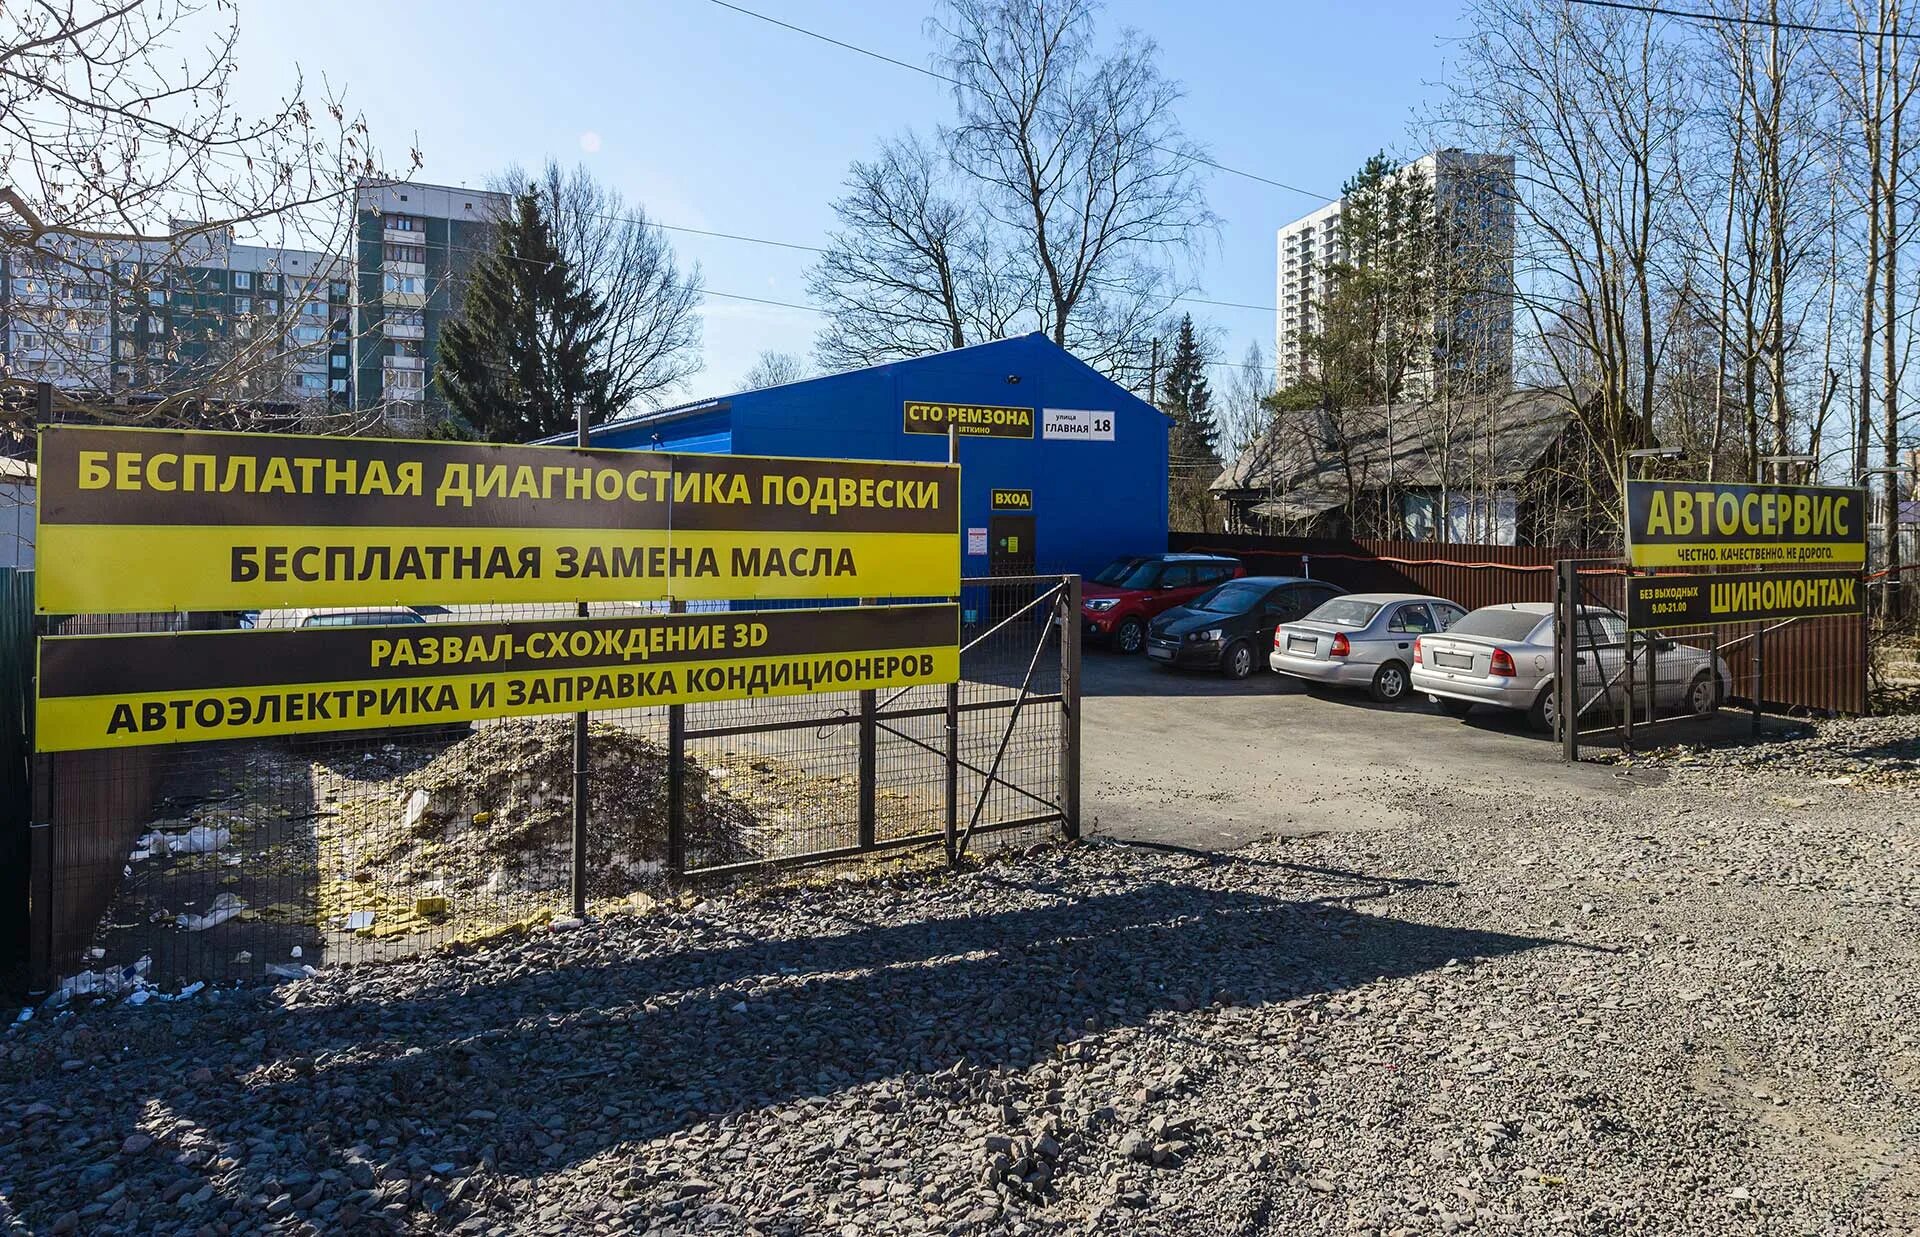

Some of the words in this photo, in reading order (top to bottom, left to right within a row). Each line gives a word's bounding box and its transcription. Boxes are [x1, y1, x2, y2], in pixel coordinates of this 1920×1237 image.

[909, 405, 943, 422] СТО
[947, 407, 1030, 425] РЕМЗОНА
[1056, 414, 1077, 422] улица
[1045, 423, 1089, 433] ГЛАВНАЯ
[1094, 419, 1111, 432] 18
[78, 450, 423, 497] БЕСПЛАТНАЯ
[435, 463, 751, 508] ДИАГНОСТИКА
[761, 475, 940, 515] ПОДВЕСКИ
[995, 493, 1029, 507] ВХОД
[1646, 490, 1849, 537] АВТОСЕРВИС
[1677, 549, 1718, 562] ЧЕСТНО.
[1720, 548, 1785, 560] КАЧЕСТВЕННО.
[1786, 548, 1797, 559] НЕ
[1798, 547, 1834, 562] ДОРОГО.
[230, 545, 541, 583] БЕСПЛАТНАЯ
[555, 546, 719, 579] ЗАМЕНА
[731, 547, 857, 578] МАСЛА
[1639, 589, 1653, 600] БЕЗ
[1654, 586, 1698, 598] ВЫХОДНЫХ
[1710, 578, 1856, 614] ШИНОМОНТАЖ
[1651, 602, 1687, 614] 9.00-21.00
[370, 624, 727, 668] РАЗВАЛ-СХОЖДЕНИЕ
[732, 622, 769, 650] 3D
[106, 683, 458, 735] АВТОЭЛЕКТРИКА
[470, 681, 496, 710] И
[506, 670, 677, 707] ЗАПРАВКА
[686, 654, 934, 695] КОНДИЦИОНЕРОВ
